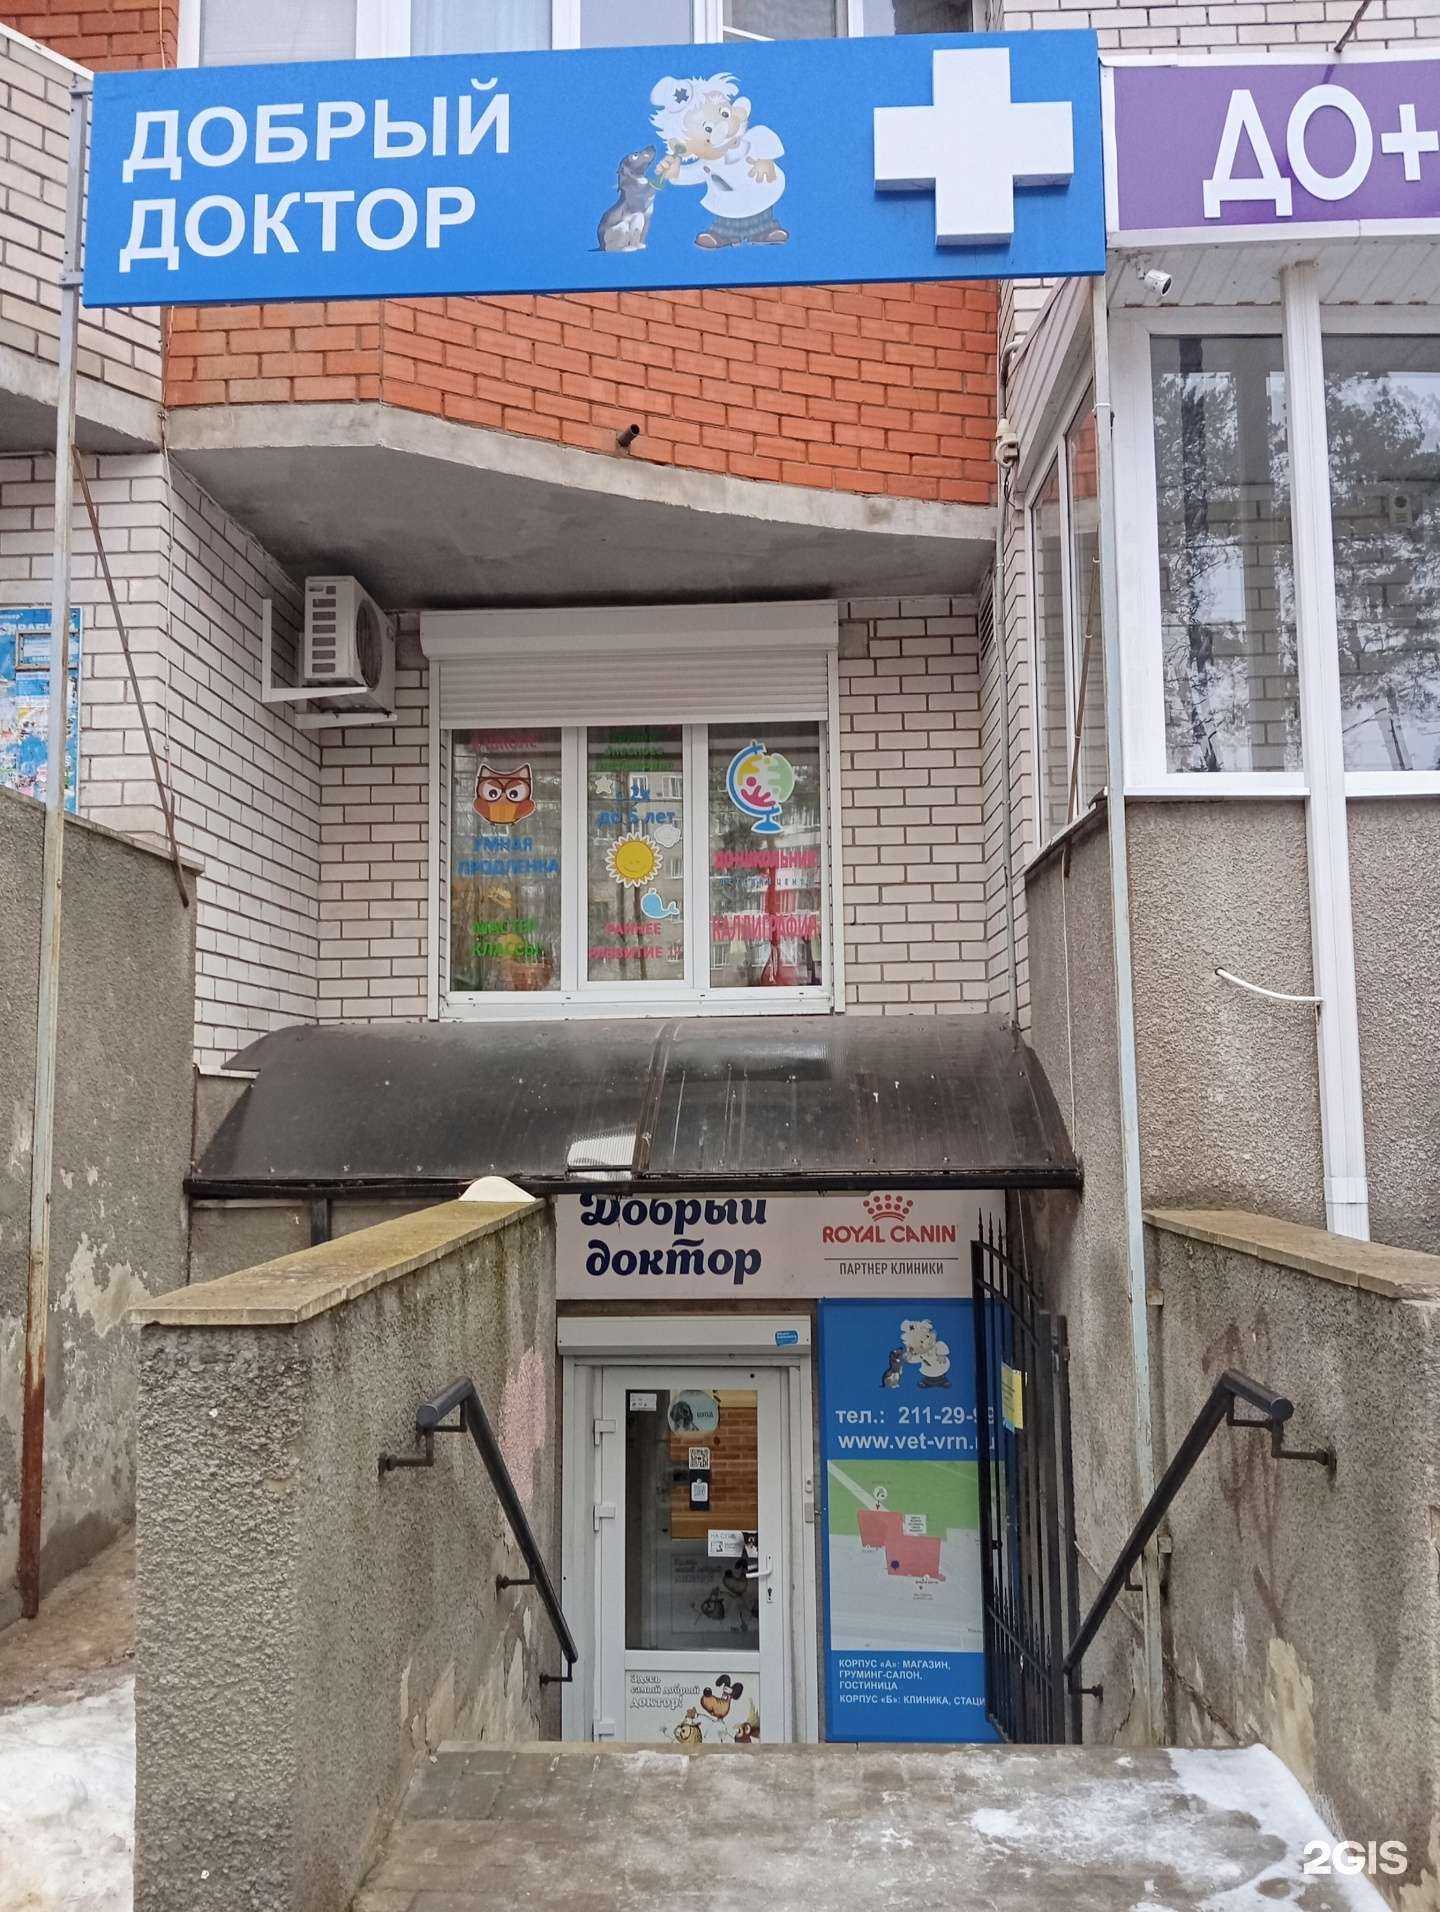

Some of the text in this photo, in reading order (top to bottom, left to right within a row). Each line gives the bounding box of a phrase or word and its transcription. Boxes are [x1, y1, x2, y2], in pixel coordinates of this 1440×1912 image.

[122, 76, 510, 183] ДОБРЫЙ
[118, 187, 476, 273] ДОКТОР
[822, 1225, 957, 1243] ROYAL CANIN
[586, 1238, 762, 1285] доктор
[840, 1262, 944, 1275] ПАРТНЕР КЛИНИКИ
[835, 1409, 885, 1424] тел.:
[838, 1659, 878, 1668] КОРПУС
[902, 1660, 951, 1670] МАГАЗИН,
[839, 1670, 923, 1680] ГРУМИНГ-САЛОН,
[839, 1681, 898, 1690] ГОСТИНИЦА
[839, 1694, 878, 1704] КОРПУС
[903, 1695, 951, 1705] КЛИНИКА,
